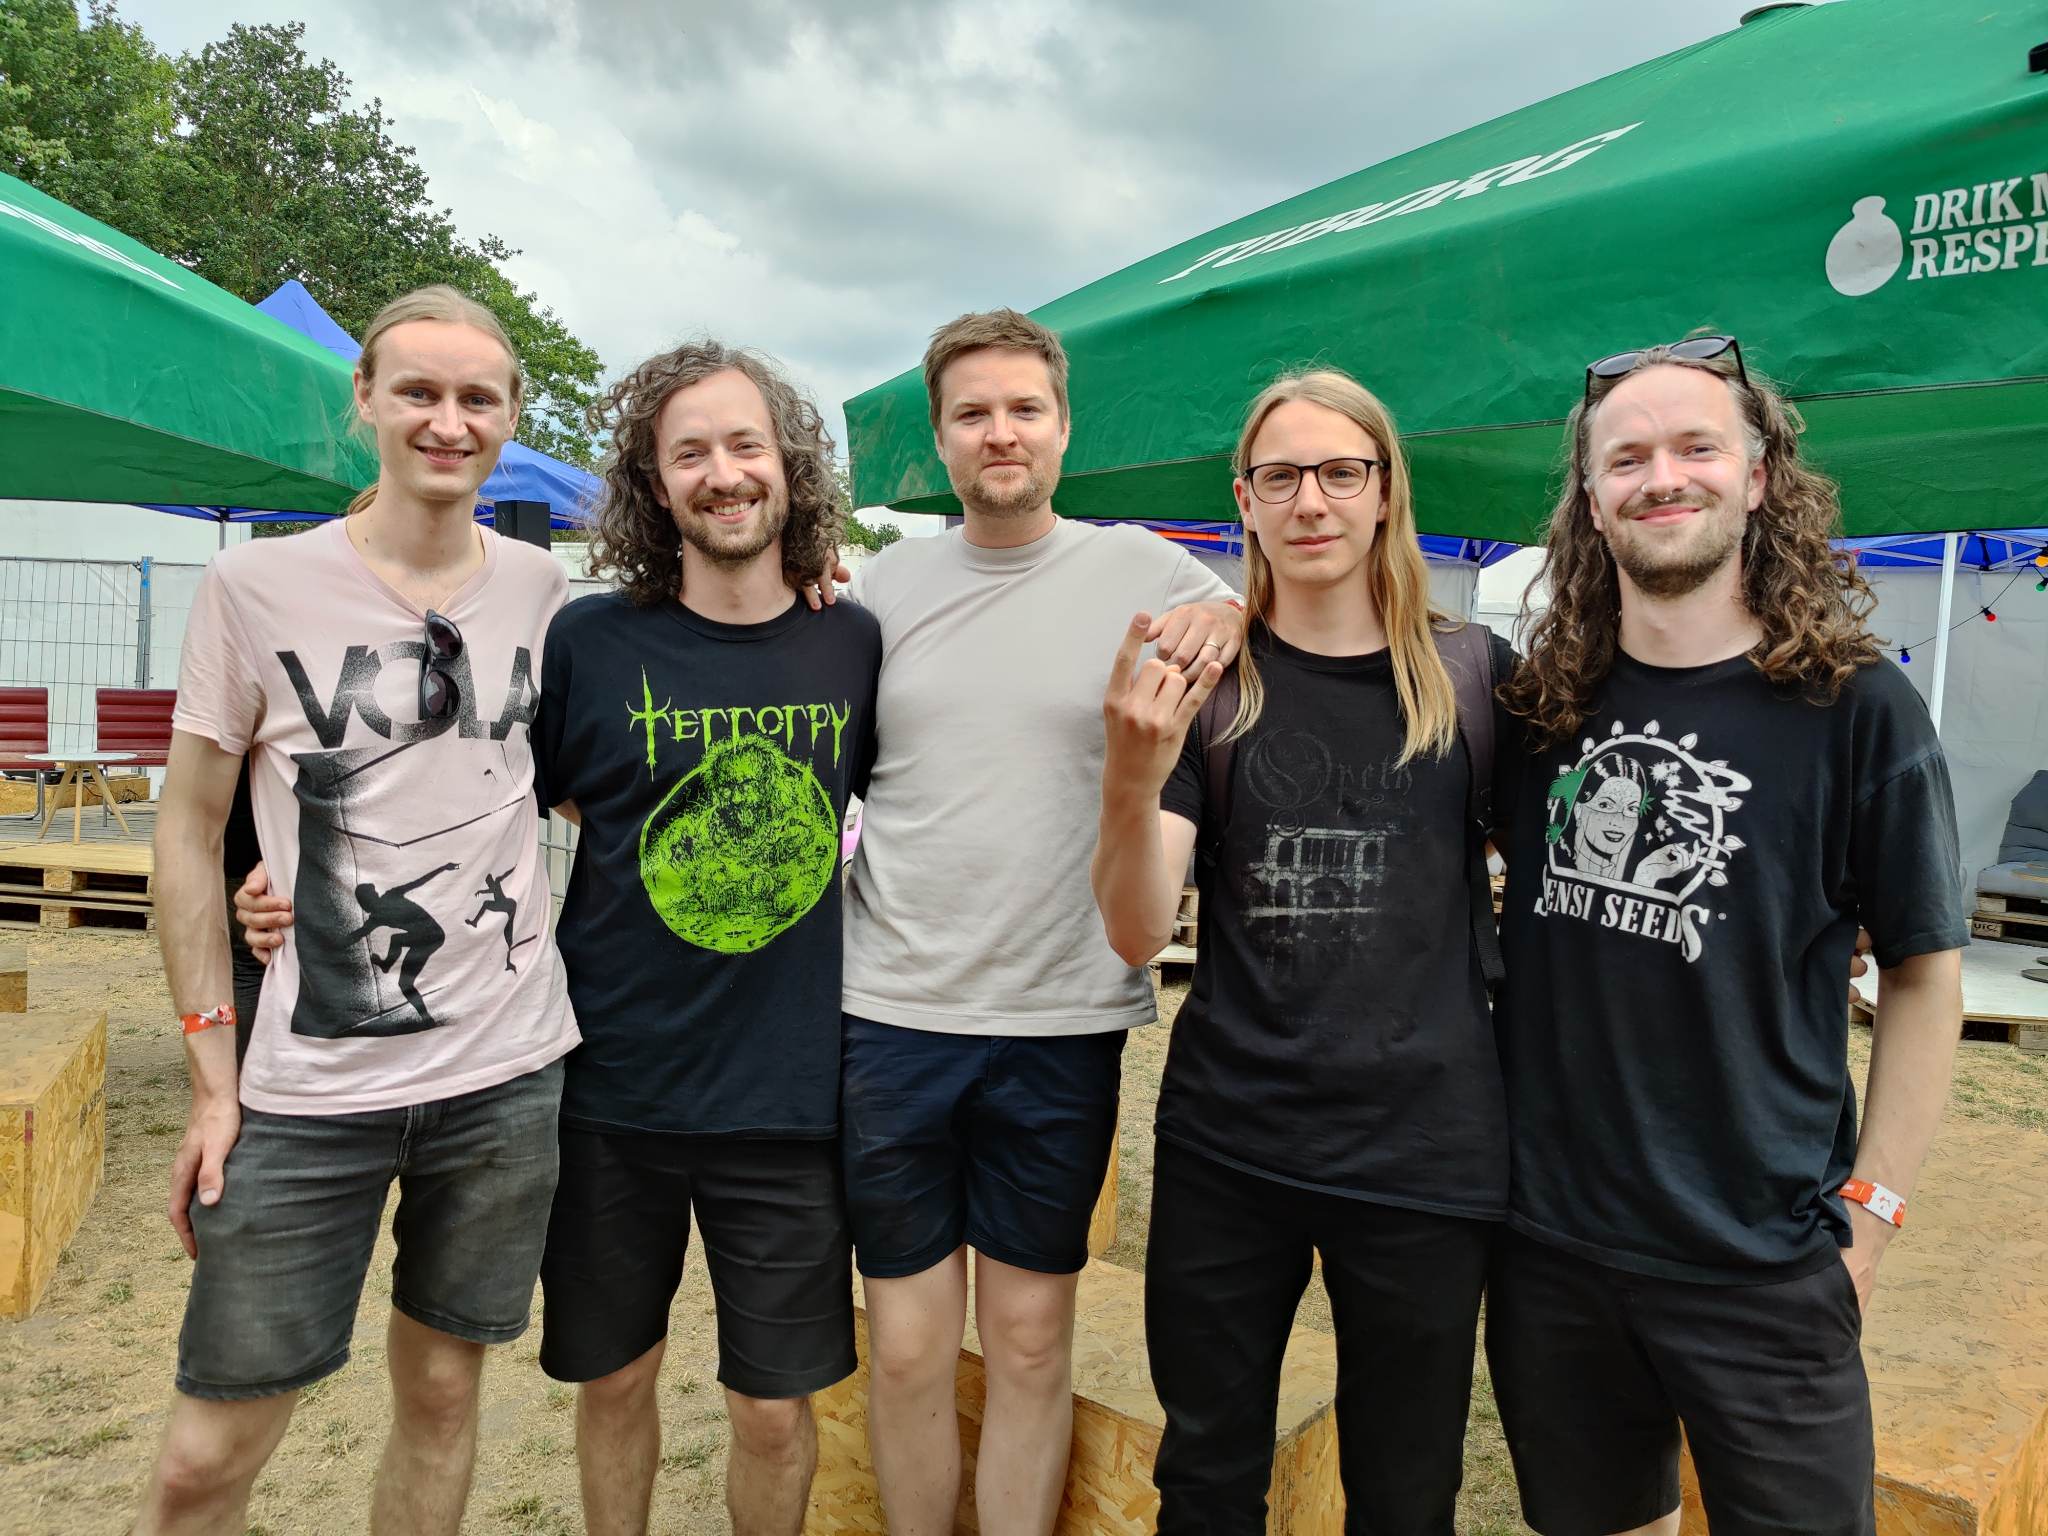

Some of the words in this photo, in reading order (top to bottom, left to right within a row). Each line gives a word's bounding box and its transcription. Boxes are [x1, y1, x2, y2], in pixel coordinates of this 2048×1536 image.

[1156, 120, 1644, 284] TUBORG
[1910, 177, 2023, 234] DRIK
[276, 640, 539, 749] VOLA
[1601, 894, 1710, 963] SEEDS
